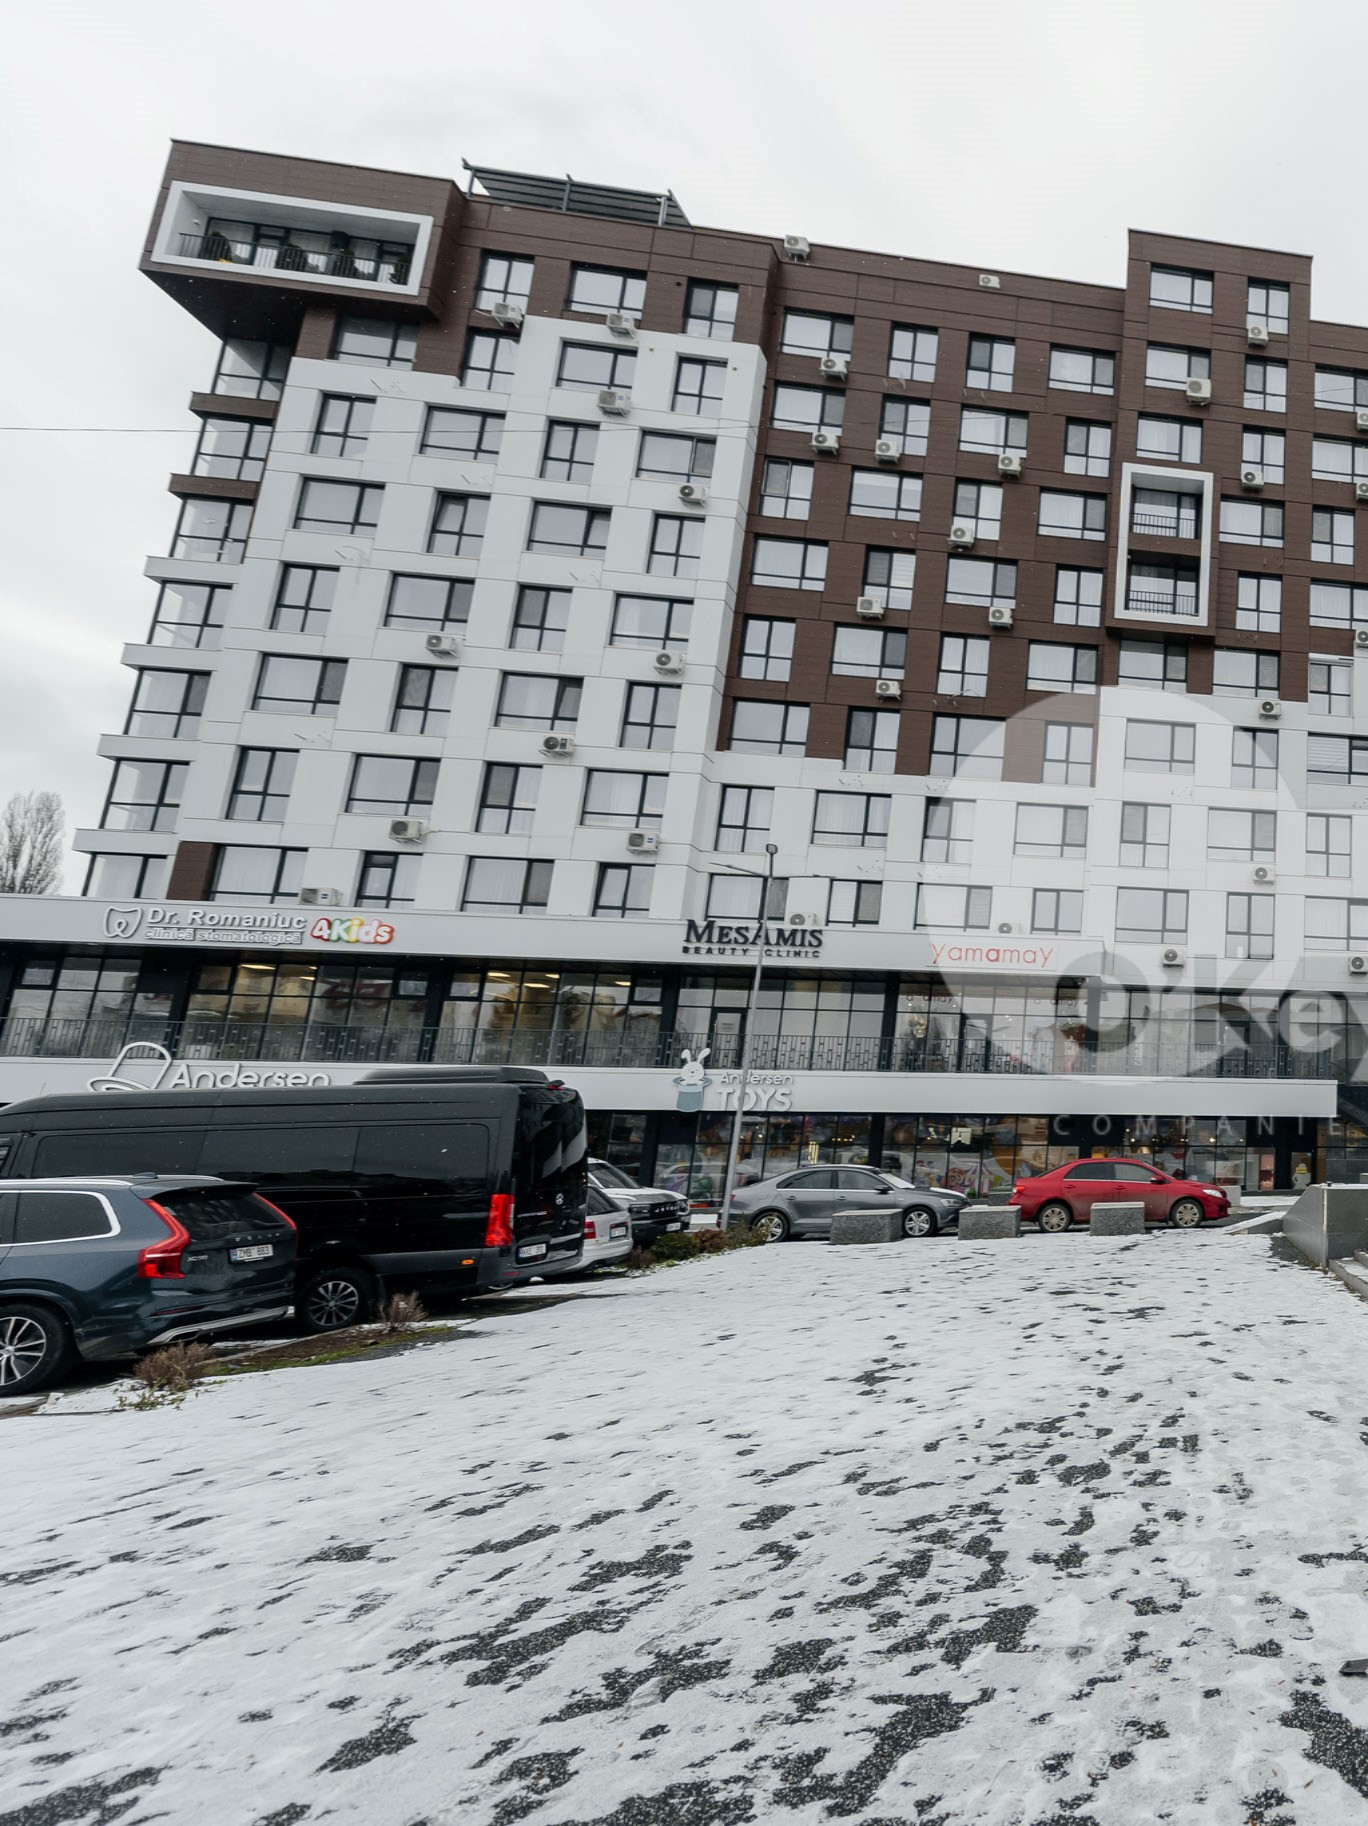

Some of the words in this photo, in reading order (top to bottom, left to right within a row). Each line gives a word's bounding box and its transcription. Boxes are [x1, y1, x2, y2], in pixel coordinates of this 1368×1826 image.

[146, 907, 180, 926] Dr.
[188, 909, 307, 930] Romaniuc
[310, 917, 395, 945] 4Kids
[682, 945, 750, 956] BEAUTY
[764, 948, 821, 959] CLINIC
[931, 943, 1054, 968] yamamay
[168, 1062, 332, 1089] Andersen
[718, 1087, 793, 1112] TOYS
